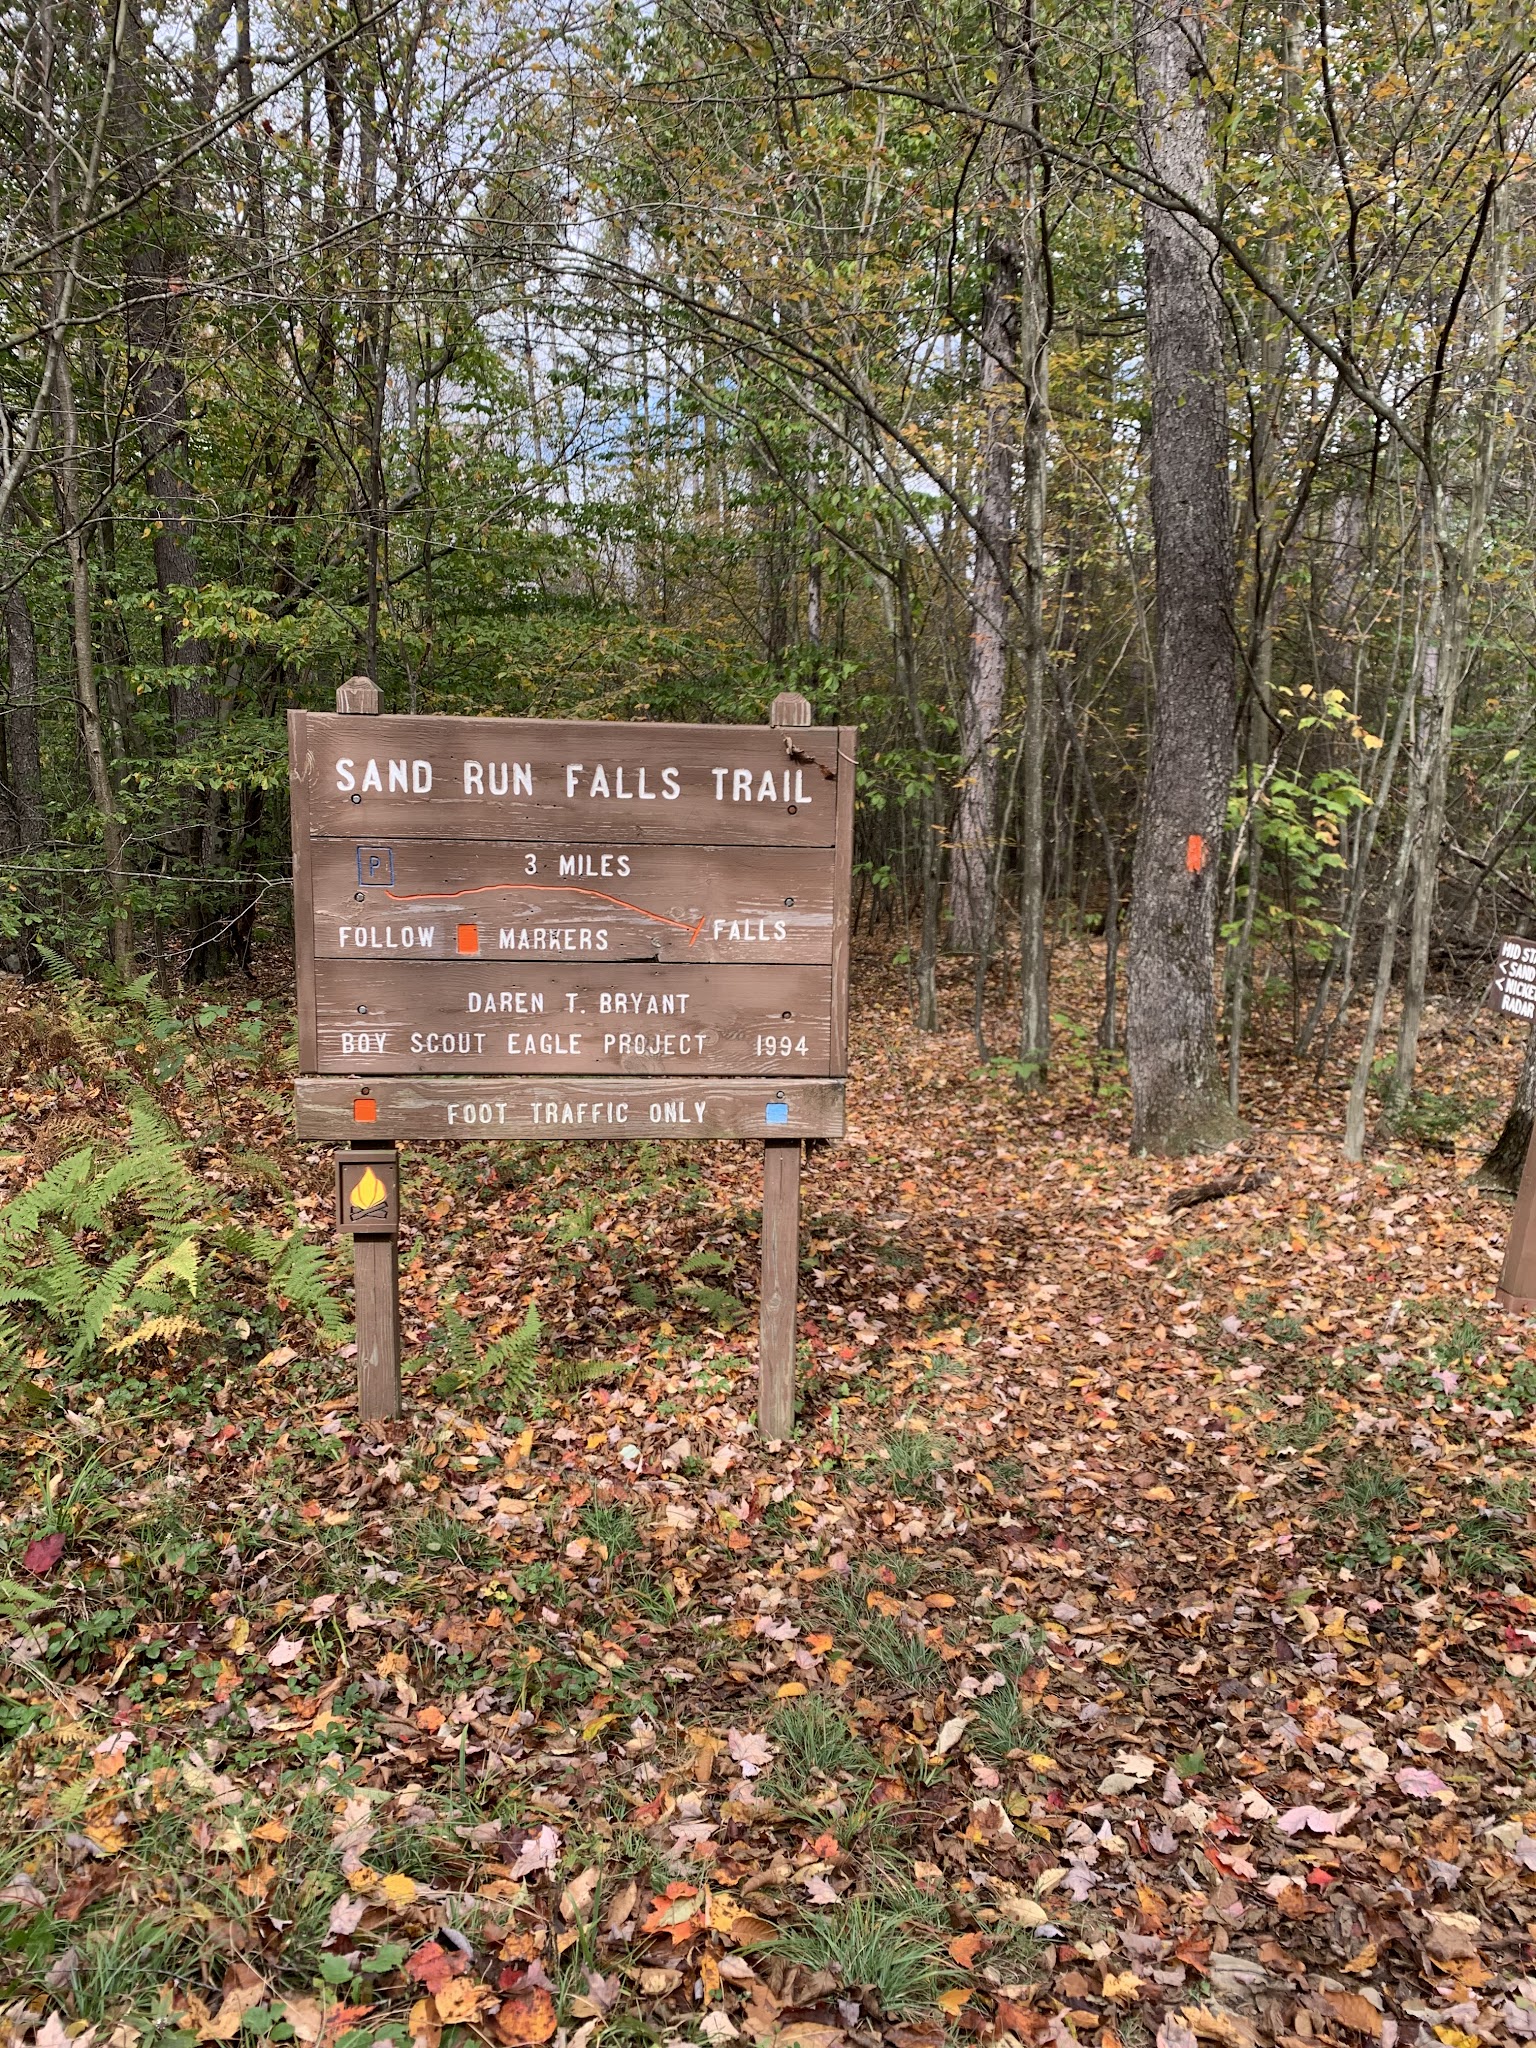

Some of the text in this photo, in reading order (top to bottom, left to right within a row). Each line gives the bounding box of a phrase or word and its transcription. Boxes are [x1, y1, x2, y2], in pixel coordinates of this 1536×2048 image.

[336, 758, 812, 803] SAND RUN FALLS TRAIL
[369, 856, 380, 876] P
[525, 854, 631, 877] 3 MILES
[339, 926, 608, 950] FOLLOW MARKERS
[714, 919, 786, 941] FALLS
[1508, 962, 1536, 982] SAND
[468, 992, 690, 1014] DAREN T. BRYANT
[1502, 994, 1535, 1018] RADAR
[342, 1032, 706, 1055] BOY SCOUT EAGLE PROJECT
[756, 1034, 809, 1057] 1994
[448, 1101, 706, 1124] FOOT TRAFFIC ONLY
